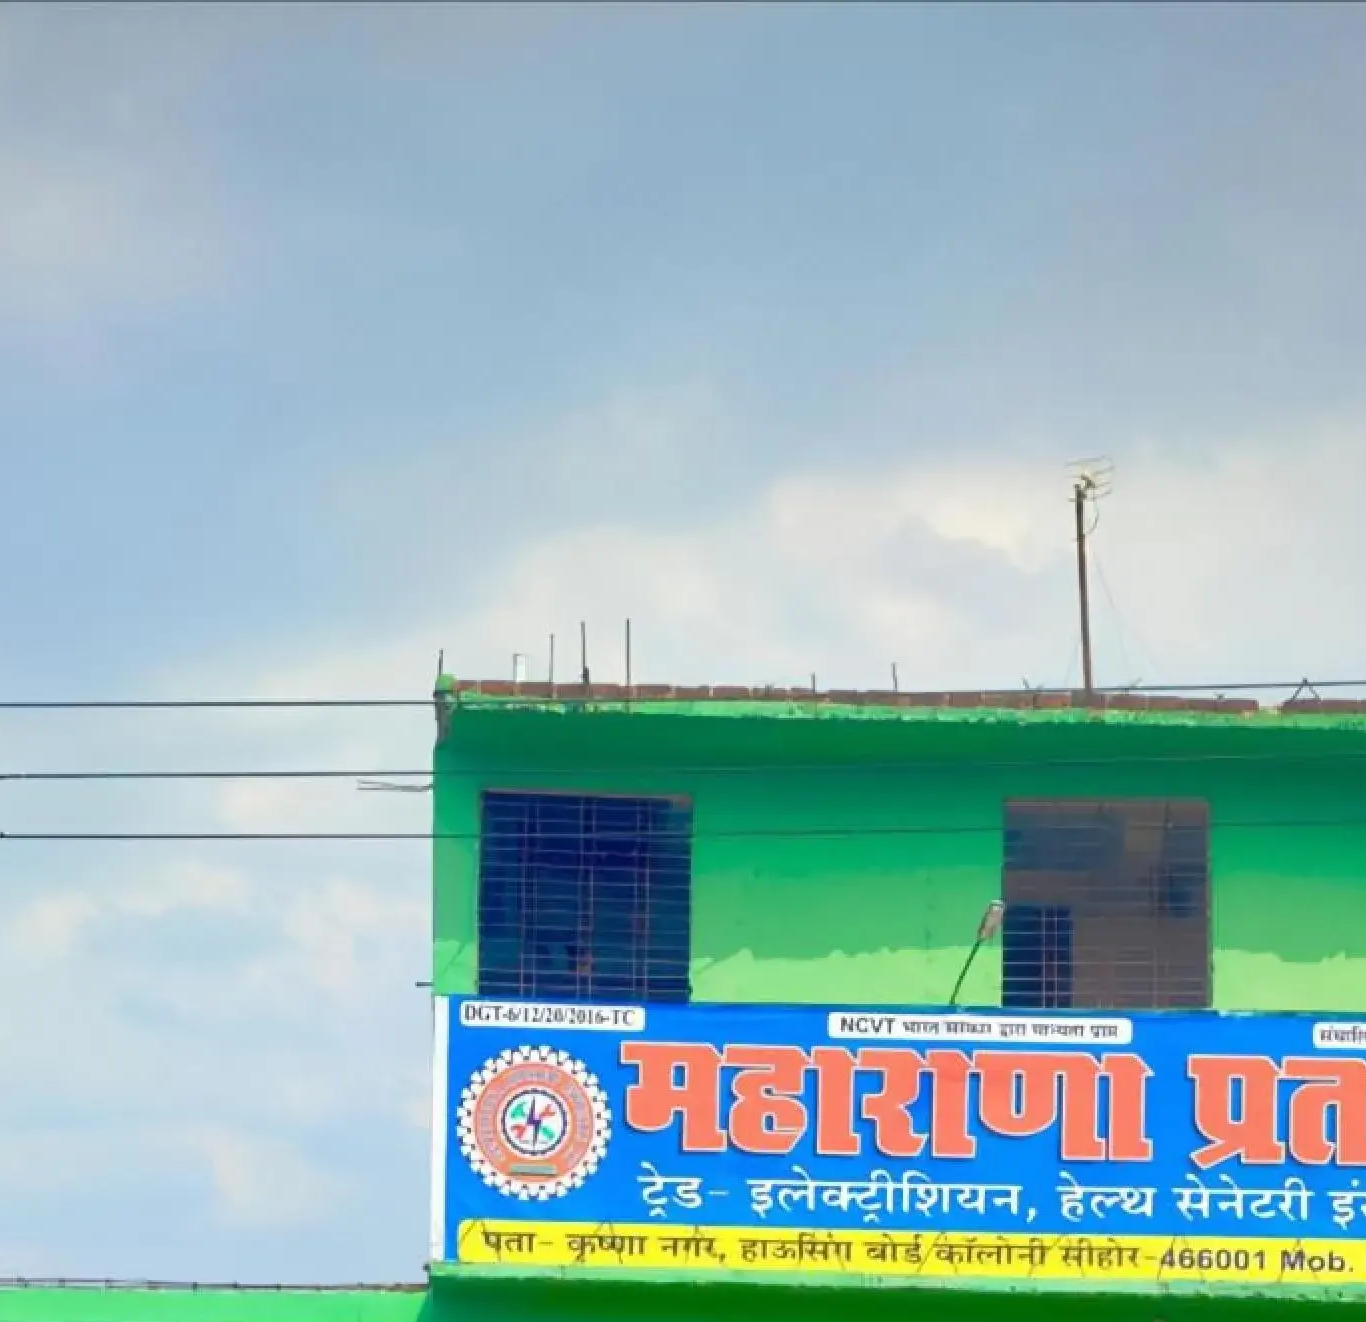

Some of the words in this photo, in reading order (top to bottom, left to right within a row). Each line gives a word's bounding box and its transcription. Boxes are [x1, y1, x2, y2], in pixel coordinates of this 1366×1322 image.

[840, 1017, 895, 1034] NCVT
[620, 1042, 1153, 1163] महाराणा
[1056, 1172, 1157, 1222] हेल्थ
[1172, 1174, 1314, 1221] सेनेटरी
[1281, 1248, 1354, 1273] Mob.
